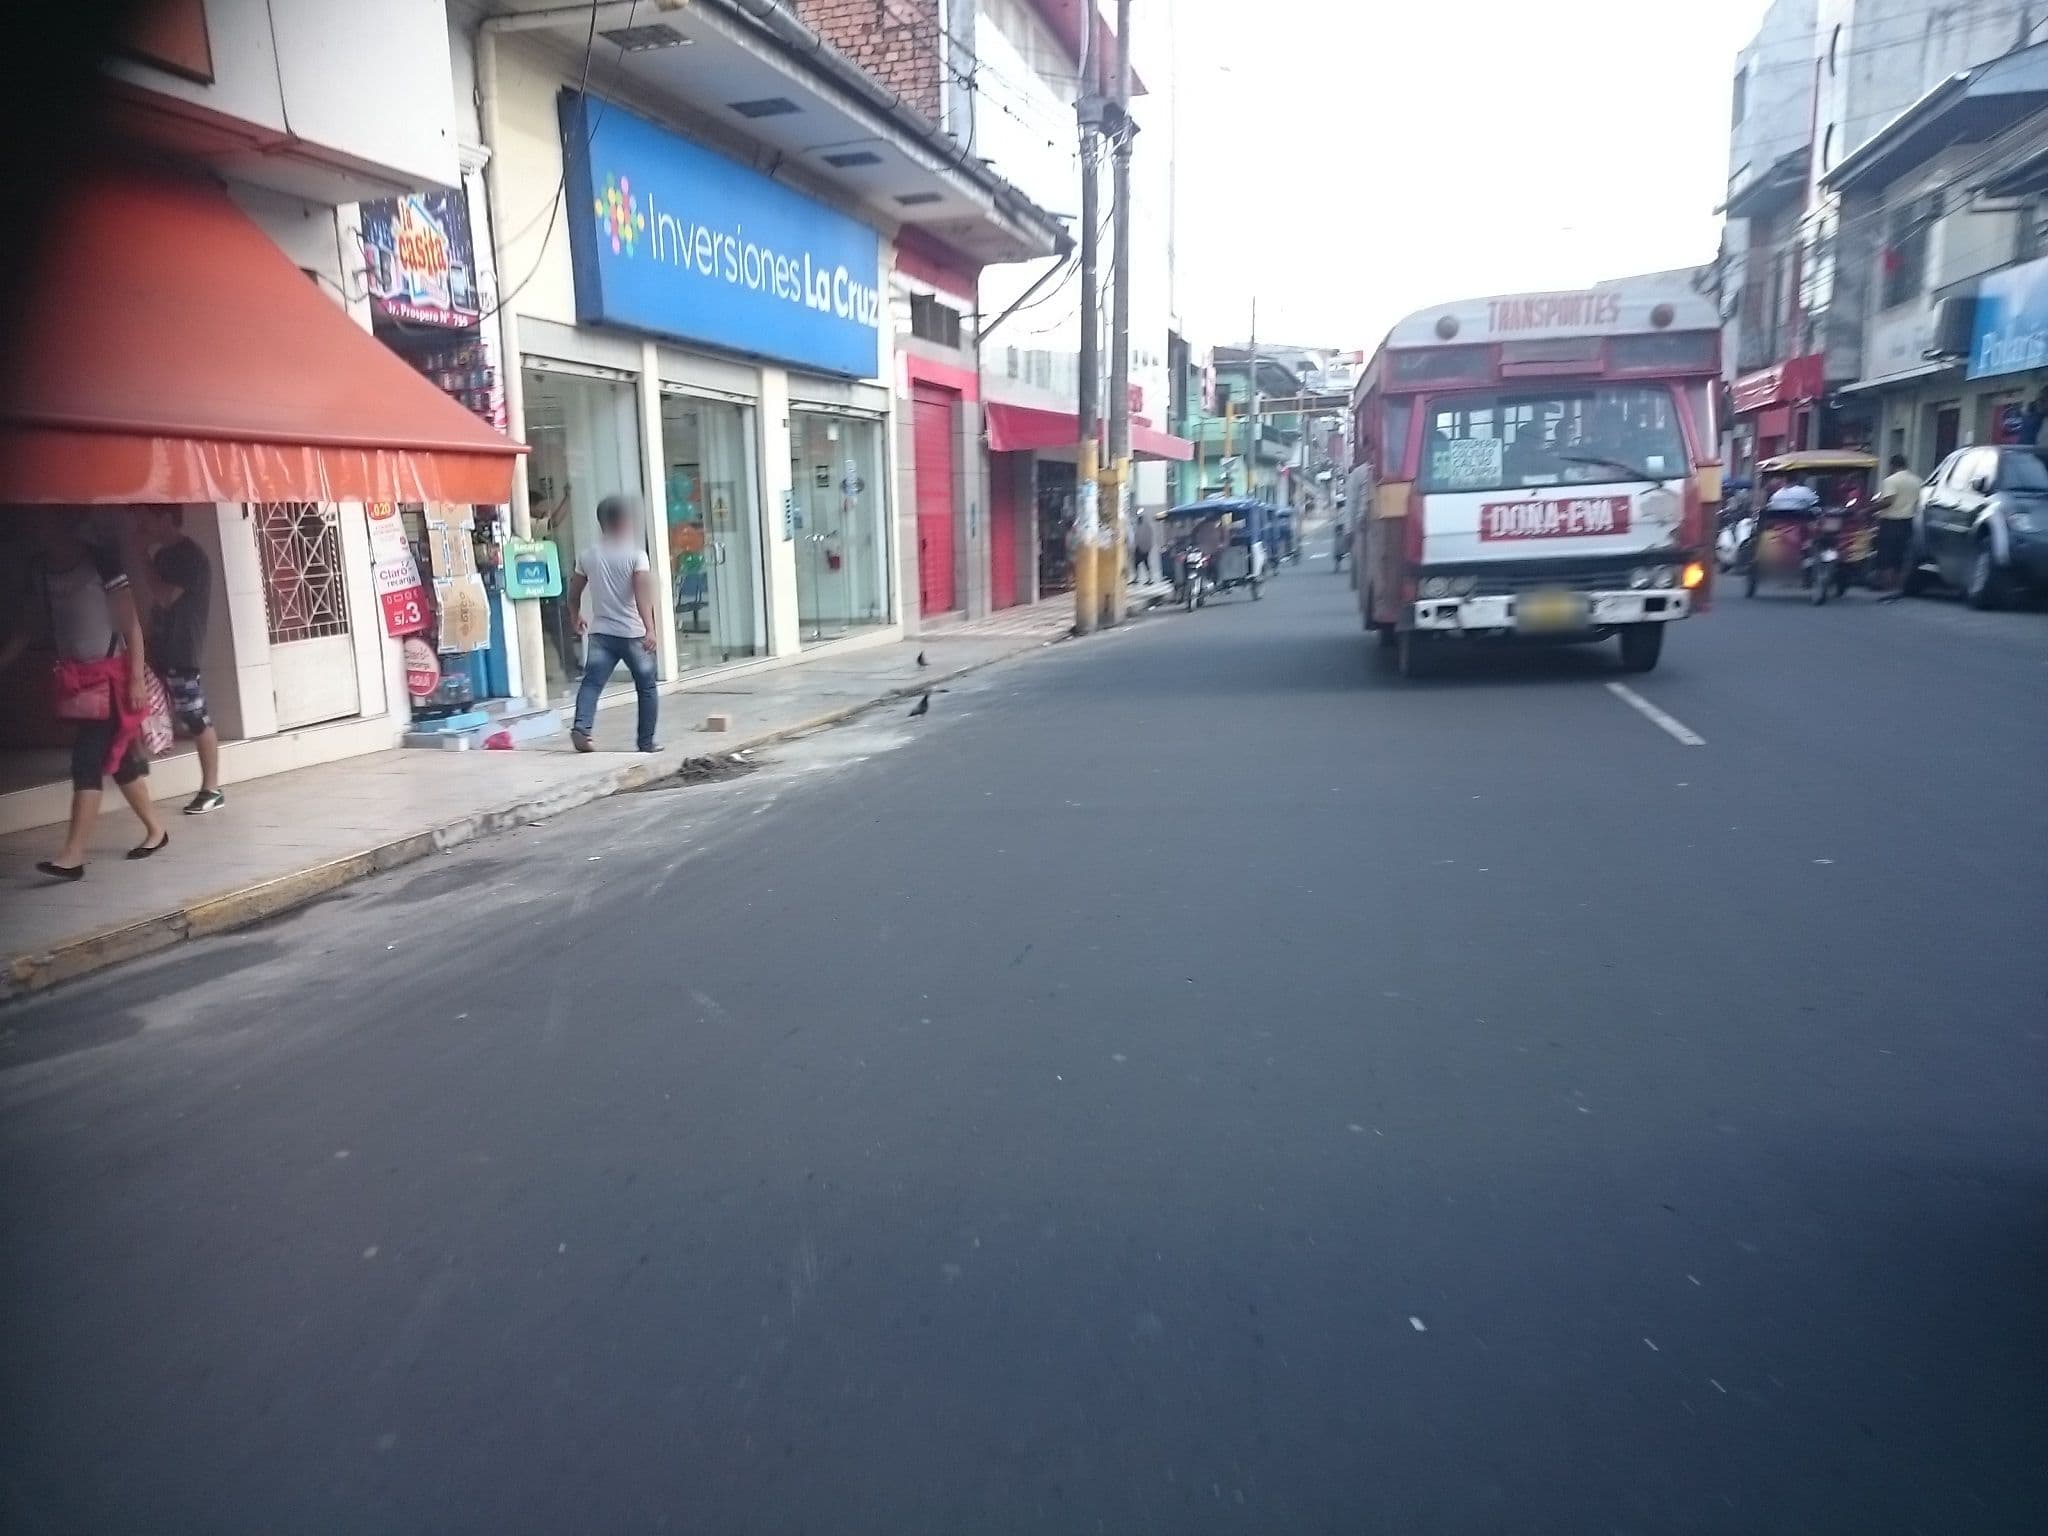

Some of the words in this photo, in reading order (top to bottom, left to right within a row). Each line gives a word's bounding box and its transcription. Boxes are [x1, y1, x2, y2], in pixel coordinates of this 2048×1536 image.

[649, 192, 801, 302] Inversiones
[804, 252, 830, 313] La
[833, 265, 879, 328] Cruz
[1488, 294, 1620, 332] TRANSPORTES
